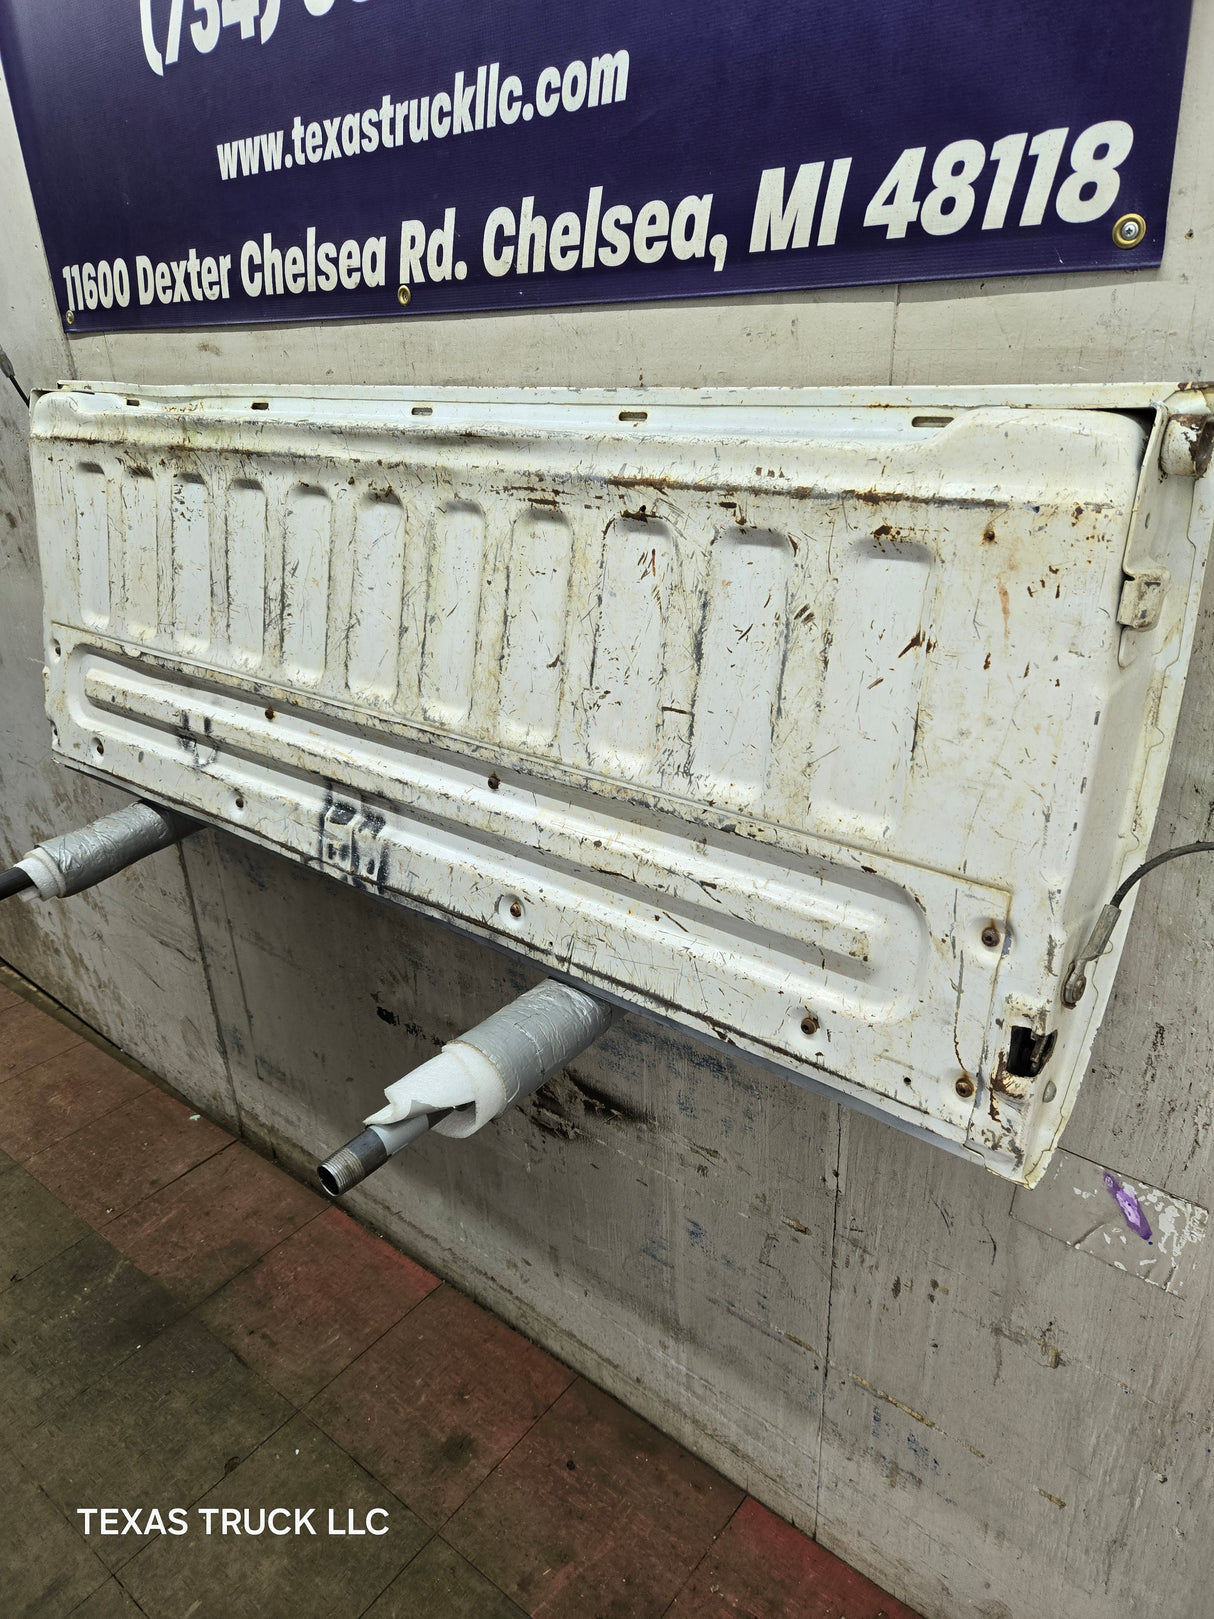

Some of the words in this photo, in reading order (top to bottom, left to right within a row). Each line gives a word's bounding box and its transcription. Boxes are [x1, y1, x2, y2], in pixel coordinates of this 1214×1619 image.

[216, 49, 630, 181] www.texastruckllc.com
[62, 257, 131, 312] 11600
[135, 249, 232, 306] Dexter
[240, 226, 387, 299] Chelsea
[399, 207, 468, 284] Rd.
[482, 185, 728, 279] Chelsea,
[748, 156, 853, 253] MI
[863, 120, 1134, 240] 48118
